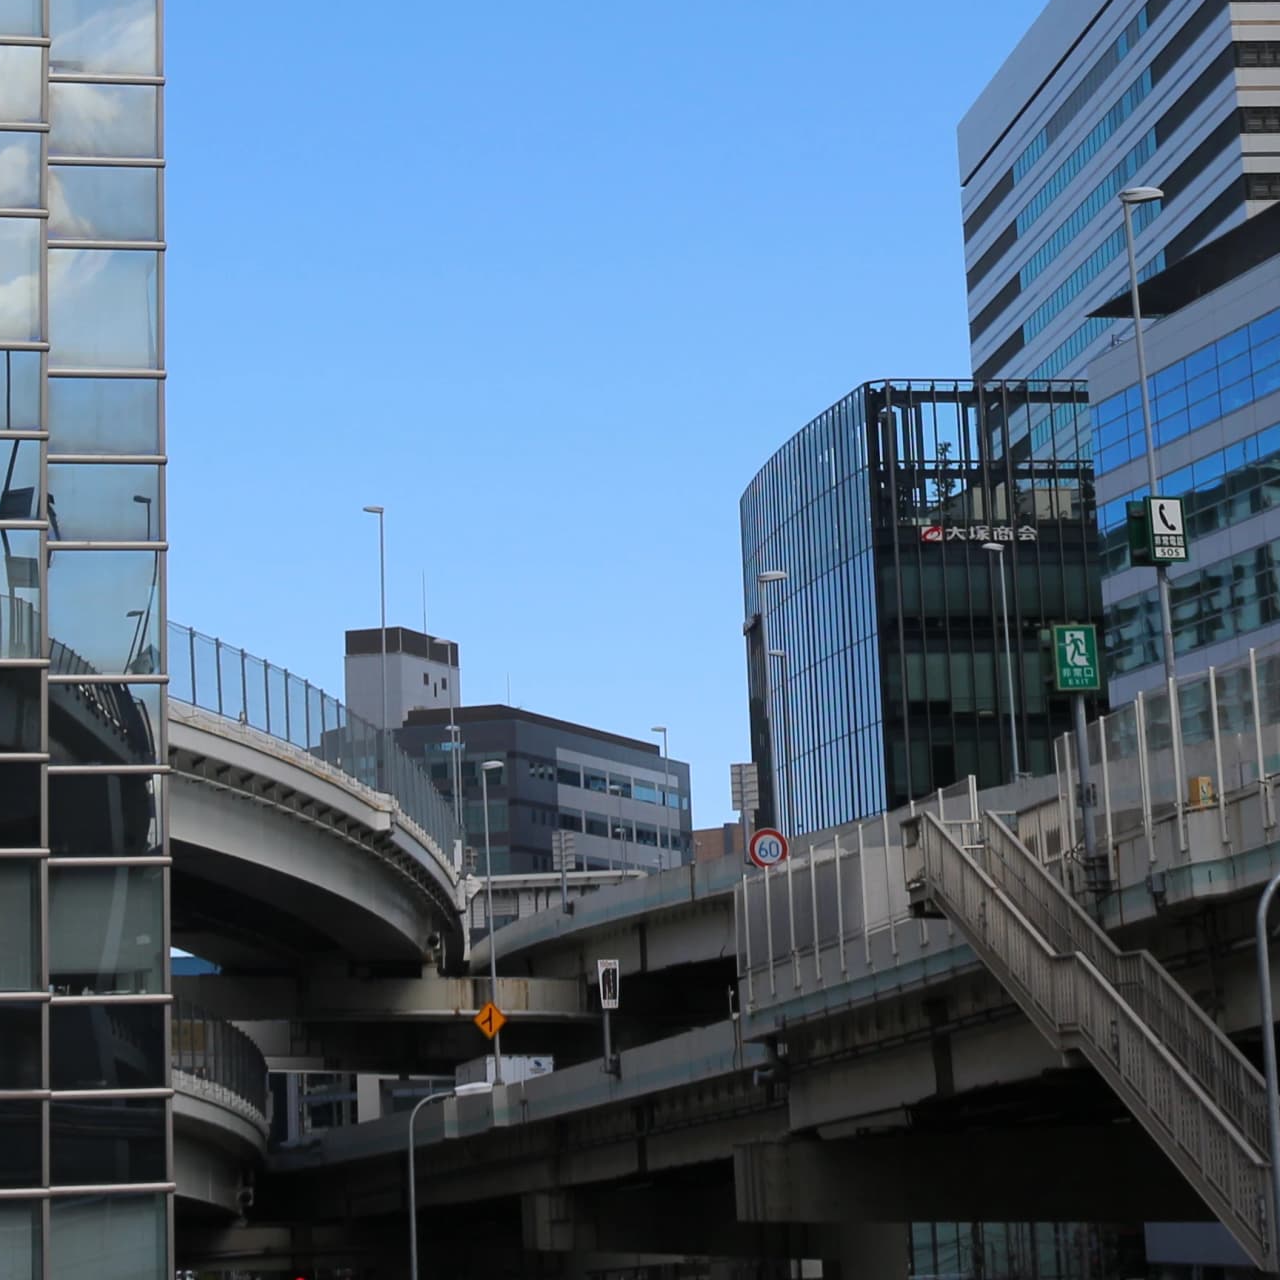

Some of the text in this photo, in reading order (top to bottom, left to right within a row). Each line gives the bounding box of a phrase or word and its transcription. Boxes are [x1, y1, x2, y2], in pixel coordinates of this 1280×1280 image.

[945, 525, 1038, 541] 大塚商会
[1160, 548, 1180, 557] SOS
[758, 839, 780, 858] 60
